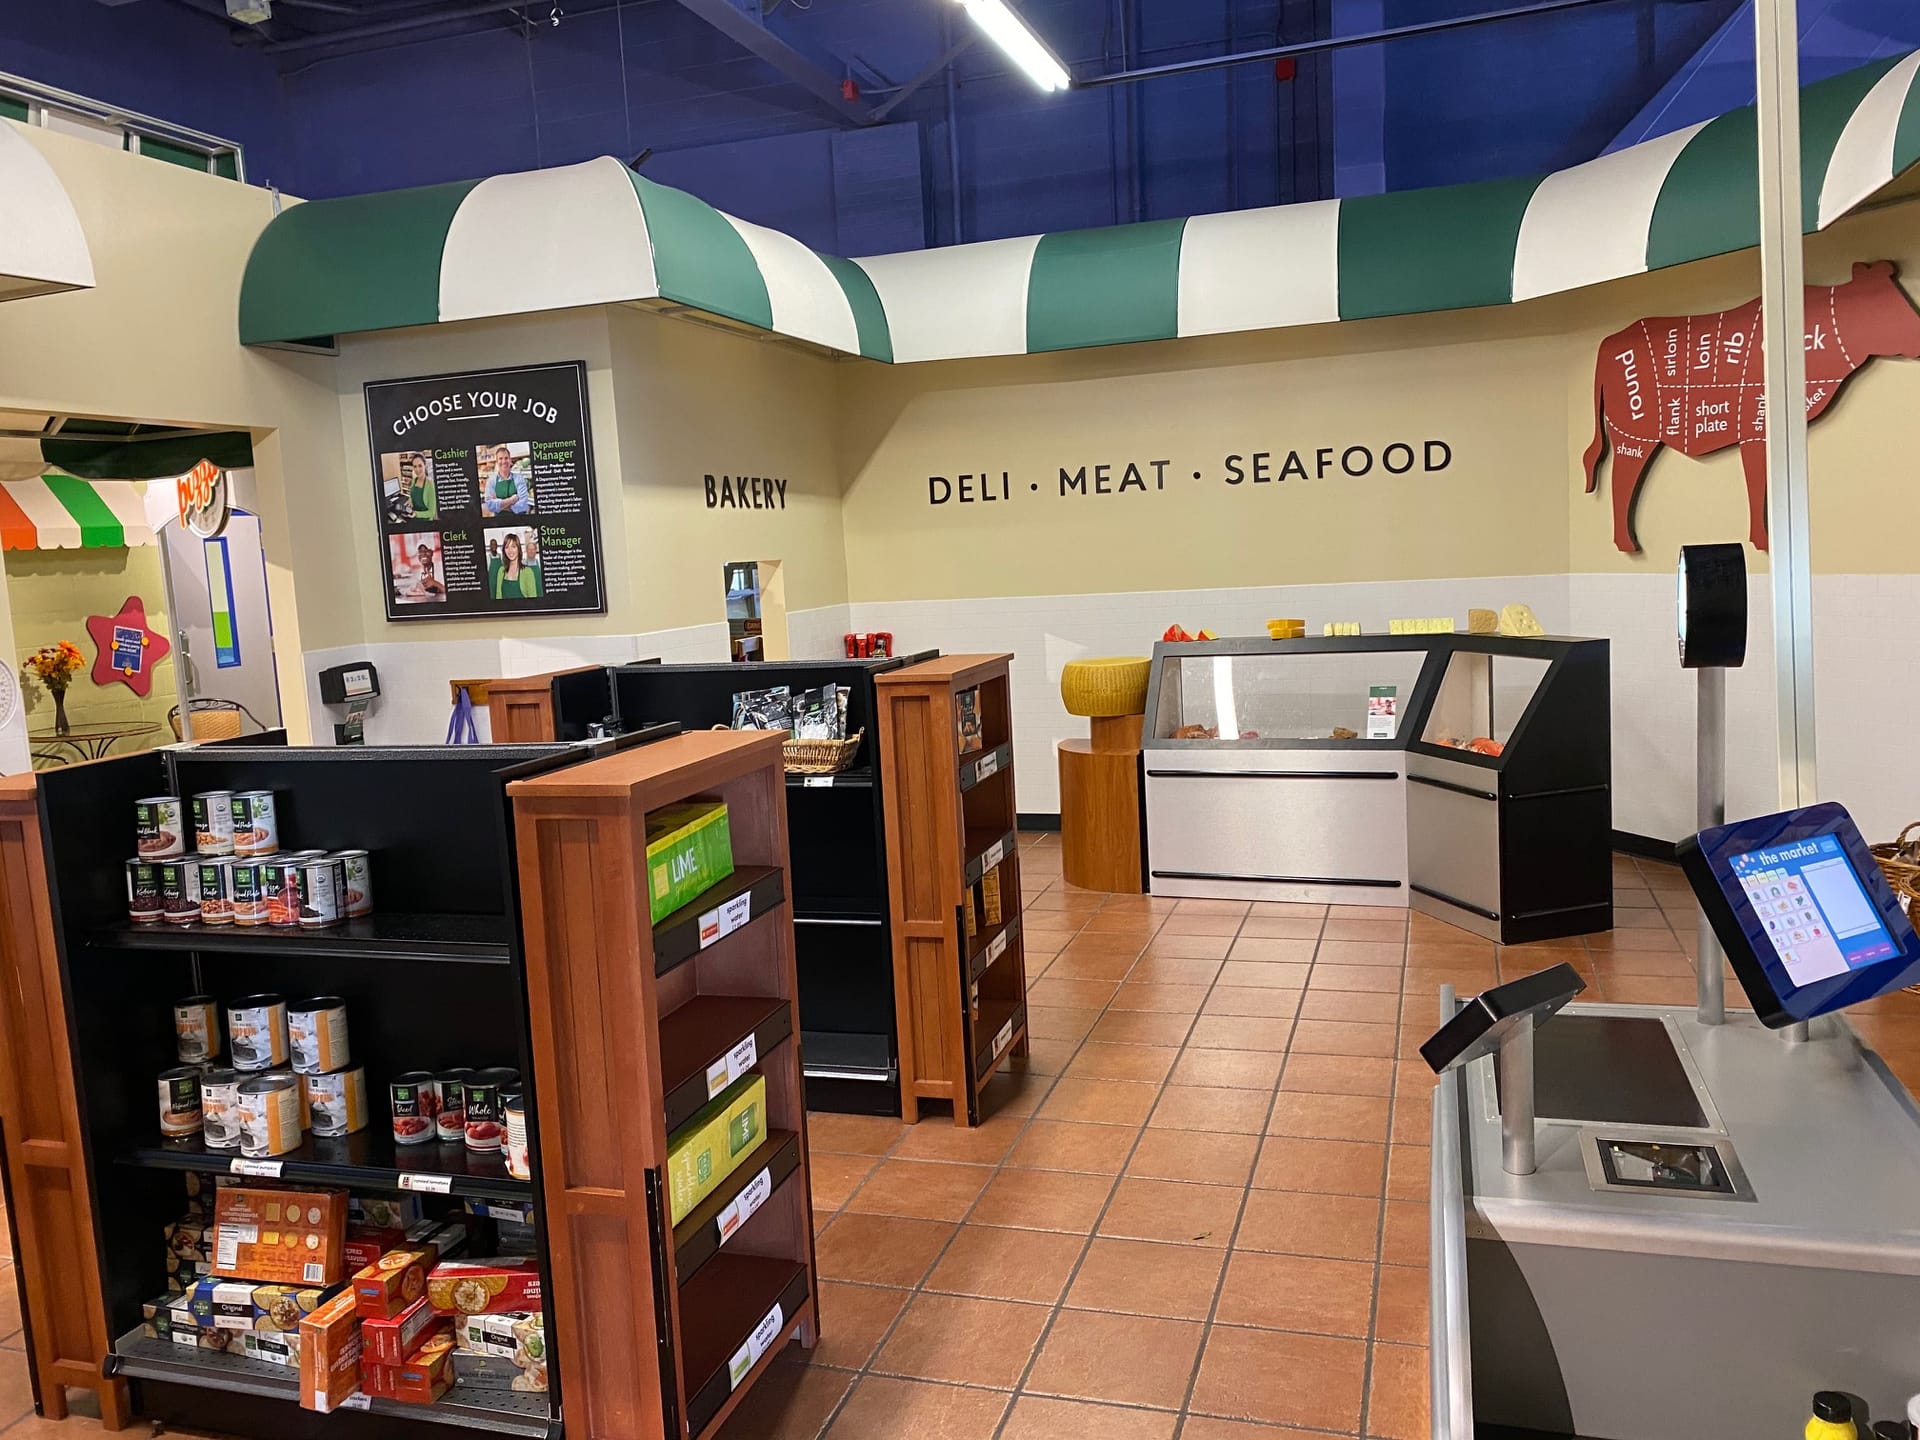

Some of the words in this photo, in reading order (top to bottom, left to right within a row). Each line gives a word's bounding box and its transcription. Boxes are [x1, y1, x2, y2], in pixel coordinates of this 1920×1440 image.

[1663, 328, 1678, 376] sirloin
[1694, 332, 1712, 371] loin
[1723, 331, 1745, 365] rib
[1615, 349, 1645, 421] round
[392, 393, 463, 436] CHOOSE
[467, 391, 518, 411] YOUR
[522, 398, 558, 424] JOB
[1666, 397, 1681, 436] flank
[1695, 400, 1730, 417] short
[1695, 418, 1728, 439] plate
[434, 448, 469, 460] Cashier
[532, 439, 577, 451] Department
[1616, 443, 1644, 459] shank
[533, 450, 574, 463] Manager
[928, 471, 1009, 504] DELI
[1059, 459, 1171, 496] MEAT
[1223, 440, 1452, 486] SEAFOOD
[704, 474, 788, 510] BAKERY
[443, 531, 468, 541] Clerk
[540, 525, 566, 535] Store
[541, 536, 581, 548] Manager
[1759, 851, 1779, 866] the
[1781, 842, 1819, 862] market
[672, 847, 698, 883] LIME
[726, 898, 748, 914] sparkling
[731, 912, 744, 923] water
[733, 1040, 753, 1059] sparkling
[738, 1054, 751, 1067] water
[468, 1103, 492, 1116] Whole
[741, 1109, 750, 1144] LIME
[743, 1176, 764, 1201] sparkling
[221, 1303, 243, 1313] Original
[755, 1314, 775, 1341] sparkling
